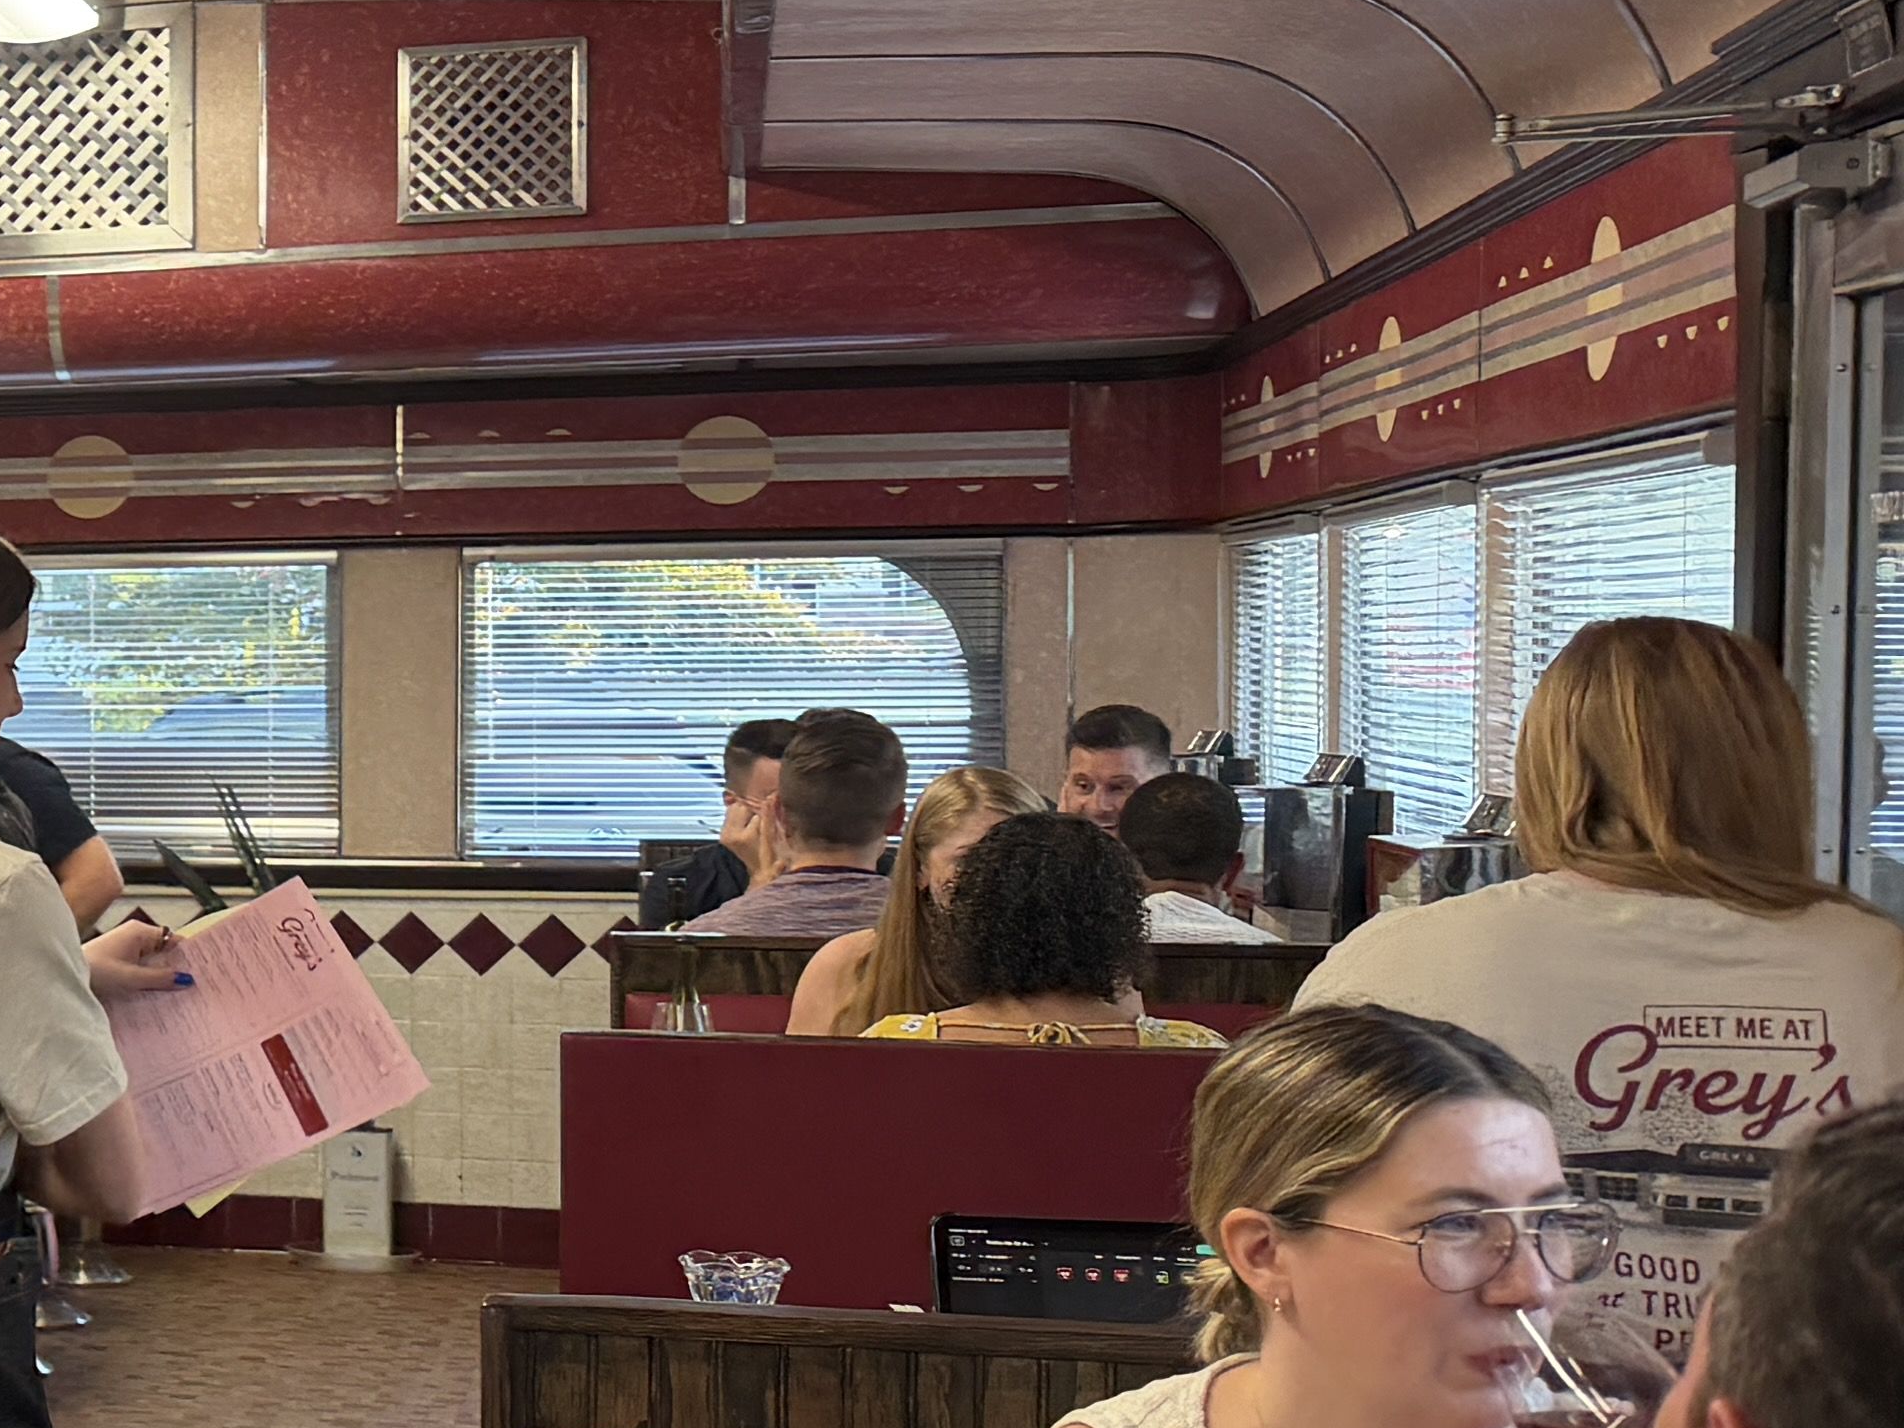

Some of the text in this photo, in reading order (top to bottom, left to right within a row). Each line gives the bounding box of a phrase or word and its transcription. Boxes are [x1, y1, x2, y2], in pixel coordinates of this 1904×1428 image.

[1655, 1016, 1817, 1042] MEET ME AT
[1574, 1024, 1853, 1141] Grey's
[1614, 1251, 1701, 1285] GOOD
